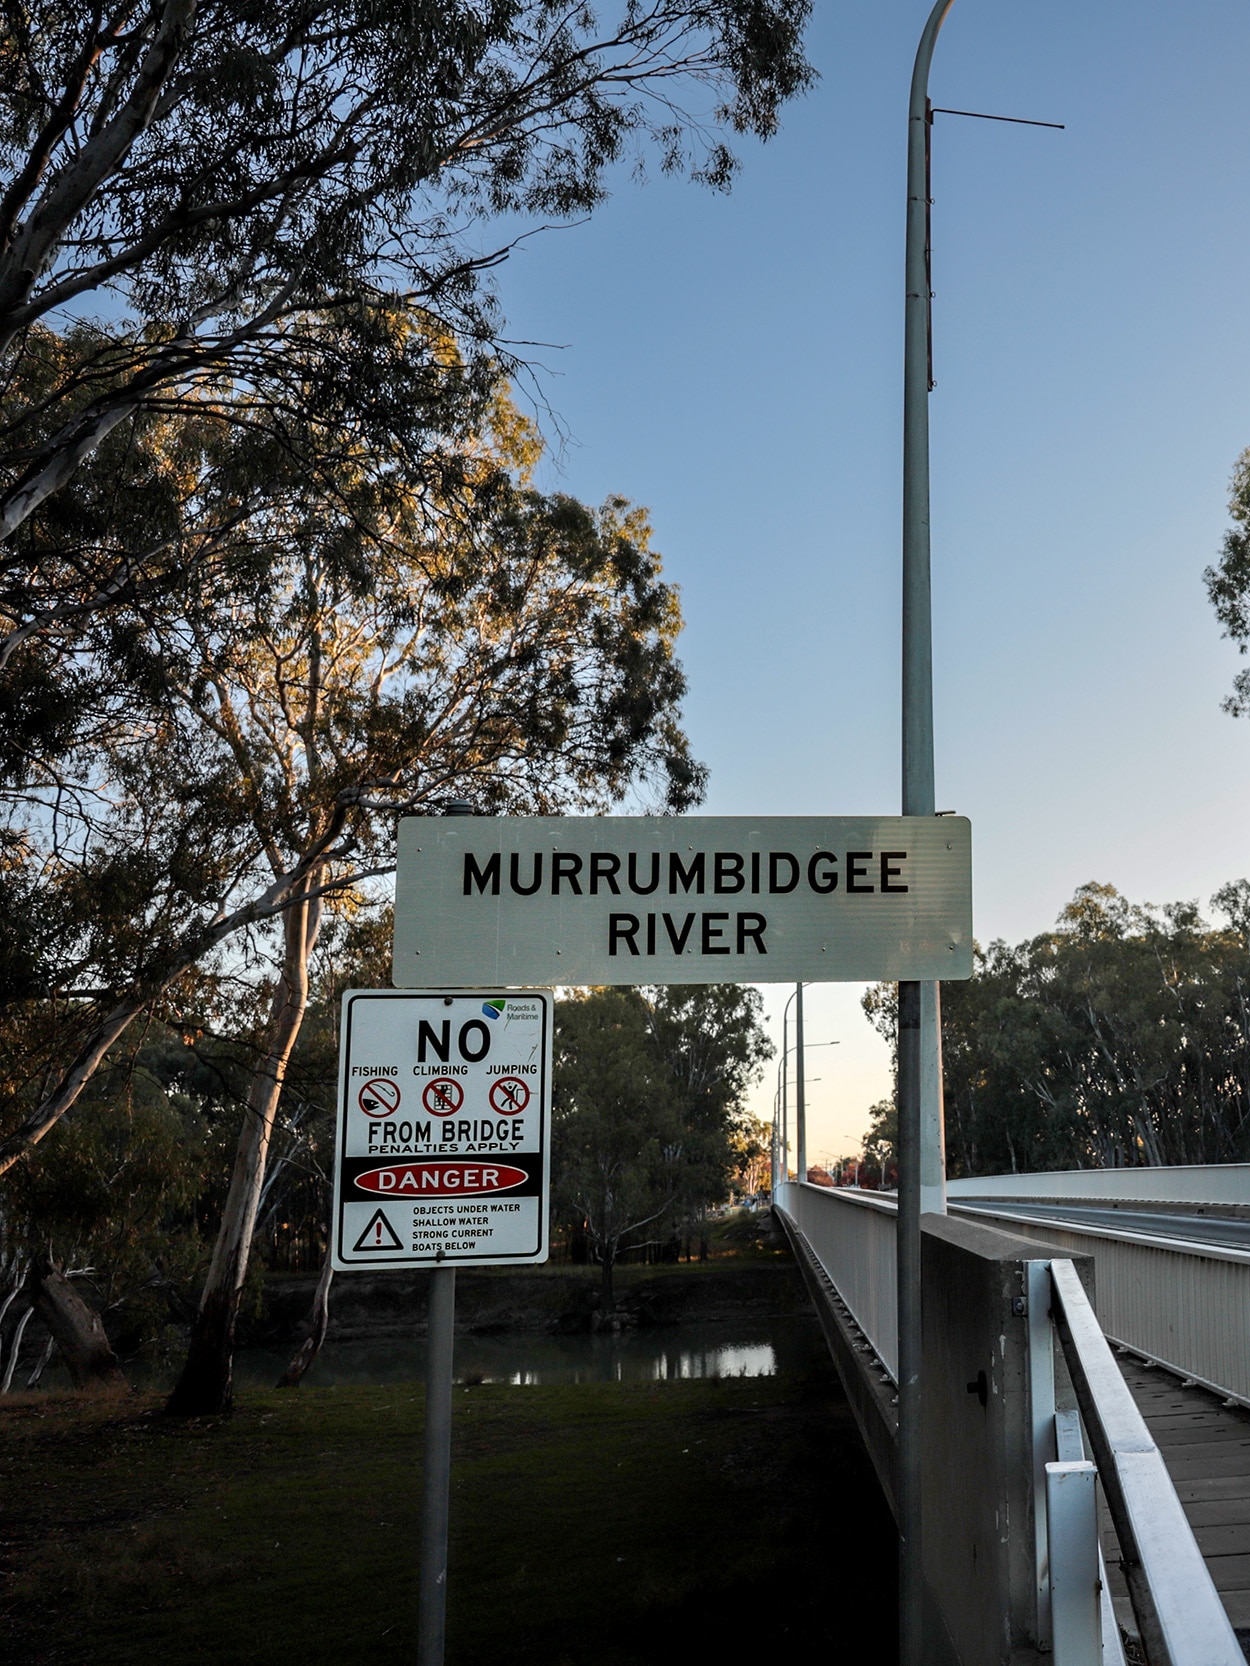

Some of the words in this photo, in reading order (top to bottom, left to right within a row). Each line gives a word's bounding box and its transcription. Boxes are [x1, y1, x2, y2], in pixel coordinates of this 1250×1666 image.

[462, 851, 910, 896] MURRUMBIDGEE
[608, 912, 768, 956] RIVER
[507, 1004, 530, 1012] Roads
[531, 1004, 537, 1012] &
[417, 1019, 491, 1063] NO
[351, 1066, 398, 1077] FISHING
[412, 1065, 469, 1076] CLIMBING
[486, 1064, 538, 1075] JUMPING
[368, 1121, 431, 1144] FROM
[442, 1119, 524, 1142] BRIDGE
[368, 1143, 459, 1154] PENALTIES
[465, 1142, 520, 1152] APPLY
[378, 1169, 499, 1190] DANGER
[413, 1205, 454, 1215] OBJECTS
[457, 1205, 488, 1213] UNDER
[490, 1203, 521, 1212] WATER
[412, 1218, 457, 1227] SHALLOW
[459, 1216, 489, 1225] WATER
[412, 1230, 449, 1240] STRONG
[451, 1228, 494, 1238] CURRENT
[412, 1242, 442, 1252] BOATS
[445, 1241, 476, 1250] BELOW
